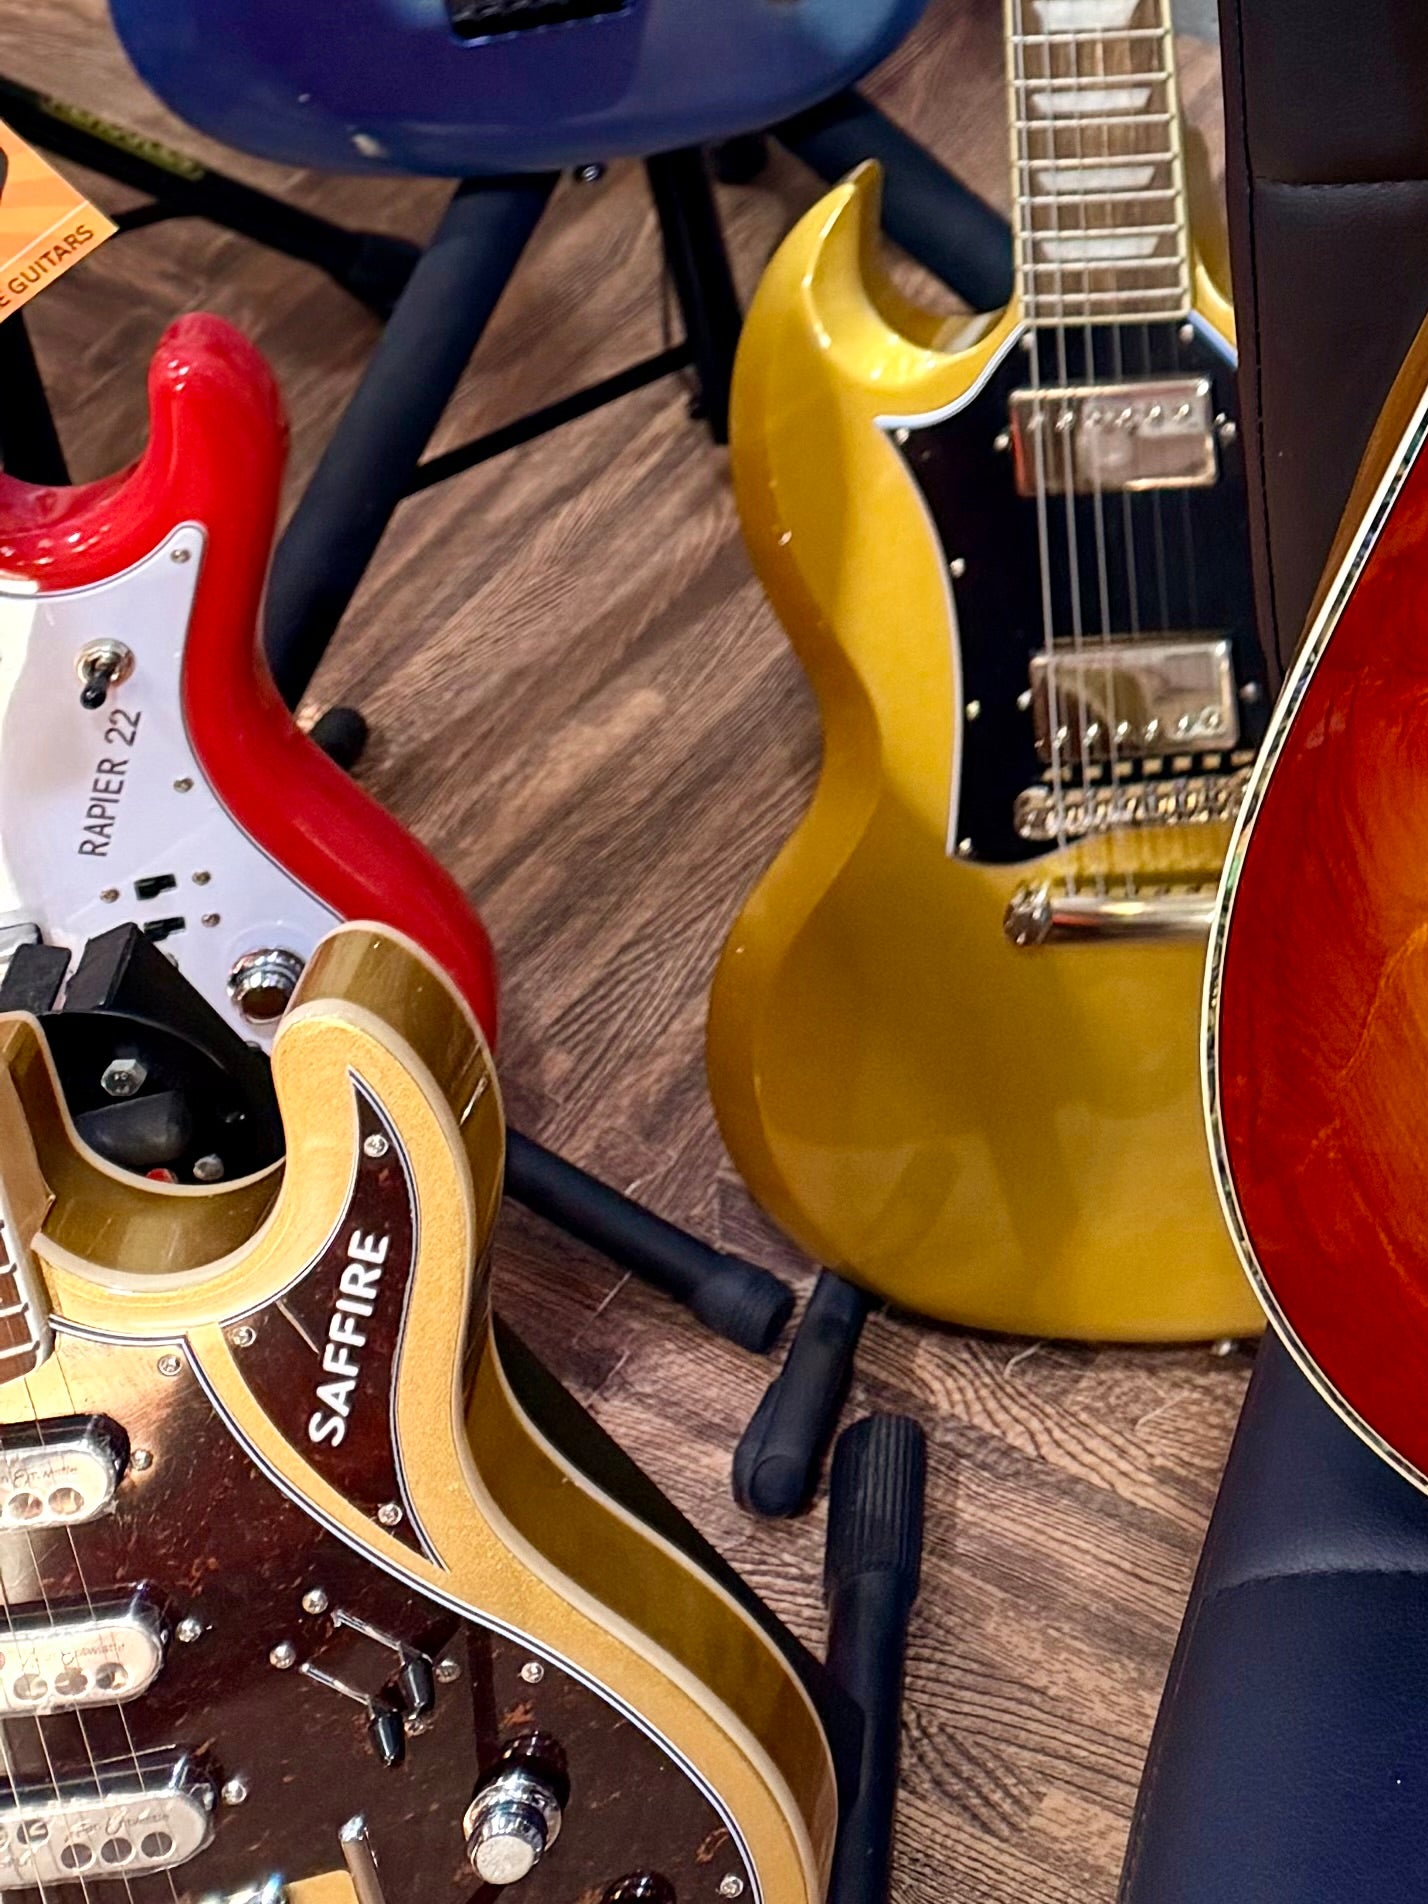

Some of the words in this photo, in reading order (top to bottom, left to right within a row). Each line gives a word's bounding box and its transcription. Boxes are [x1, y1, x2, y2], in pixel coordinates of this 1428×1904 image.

[7, 223, 96, 297] GUITARS
[78, 755, 130, 858] RAPIER
[105, 708, 142, 746] 22
[308, 1228, 392, 1447] SAFFIRE
